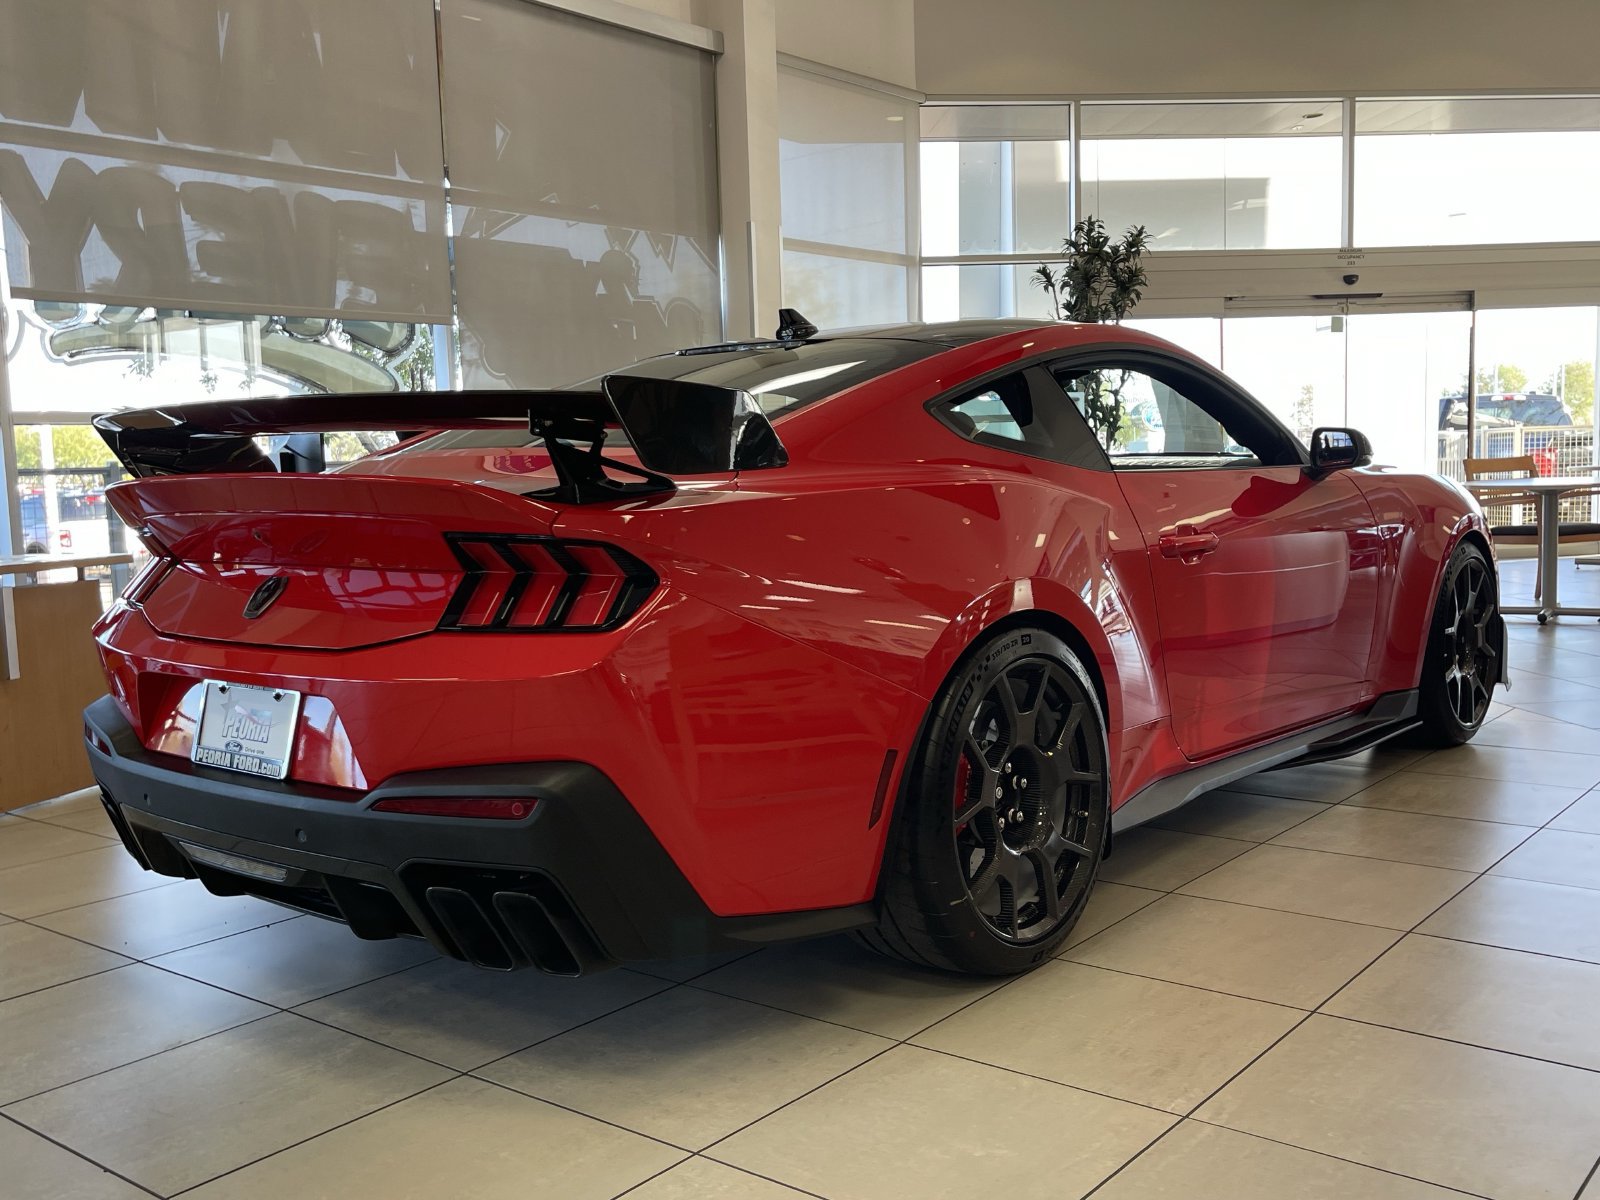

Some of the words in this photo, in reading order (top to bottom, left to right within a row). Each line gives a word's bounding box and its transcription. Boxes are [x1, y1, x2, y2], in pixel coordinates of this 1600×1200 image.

[222, 713, 270, 743] PEORIA
[196, 748, 231, 767] PEORIA
[233, 754, 280, 776] FORD.com
